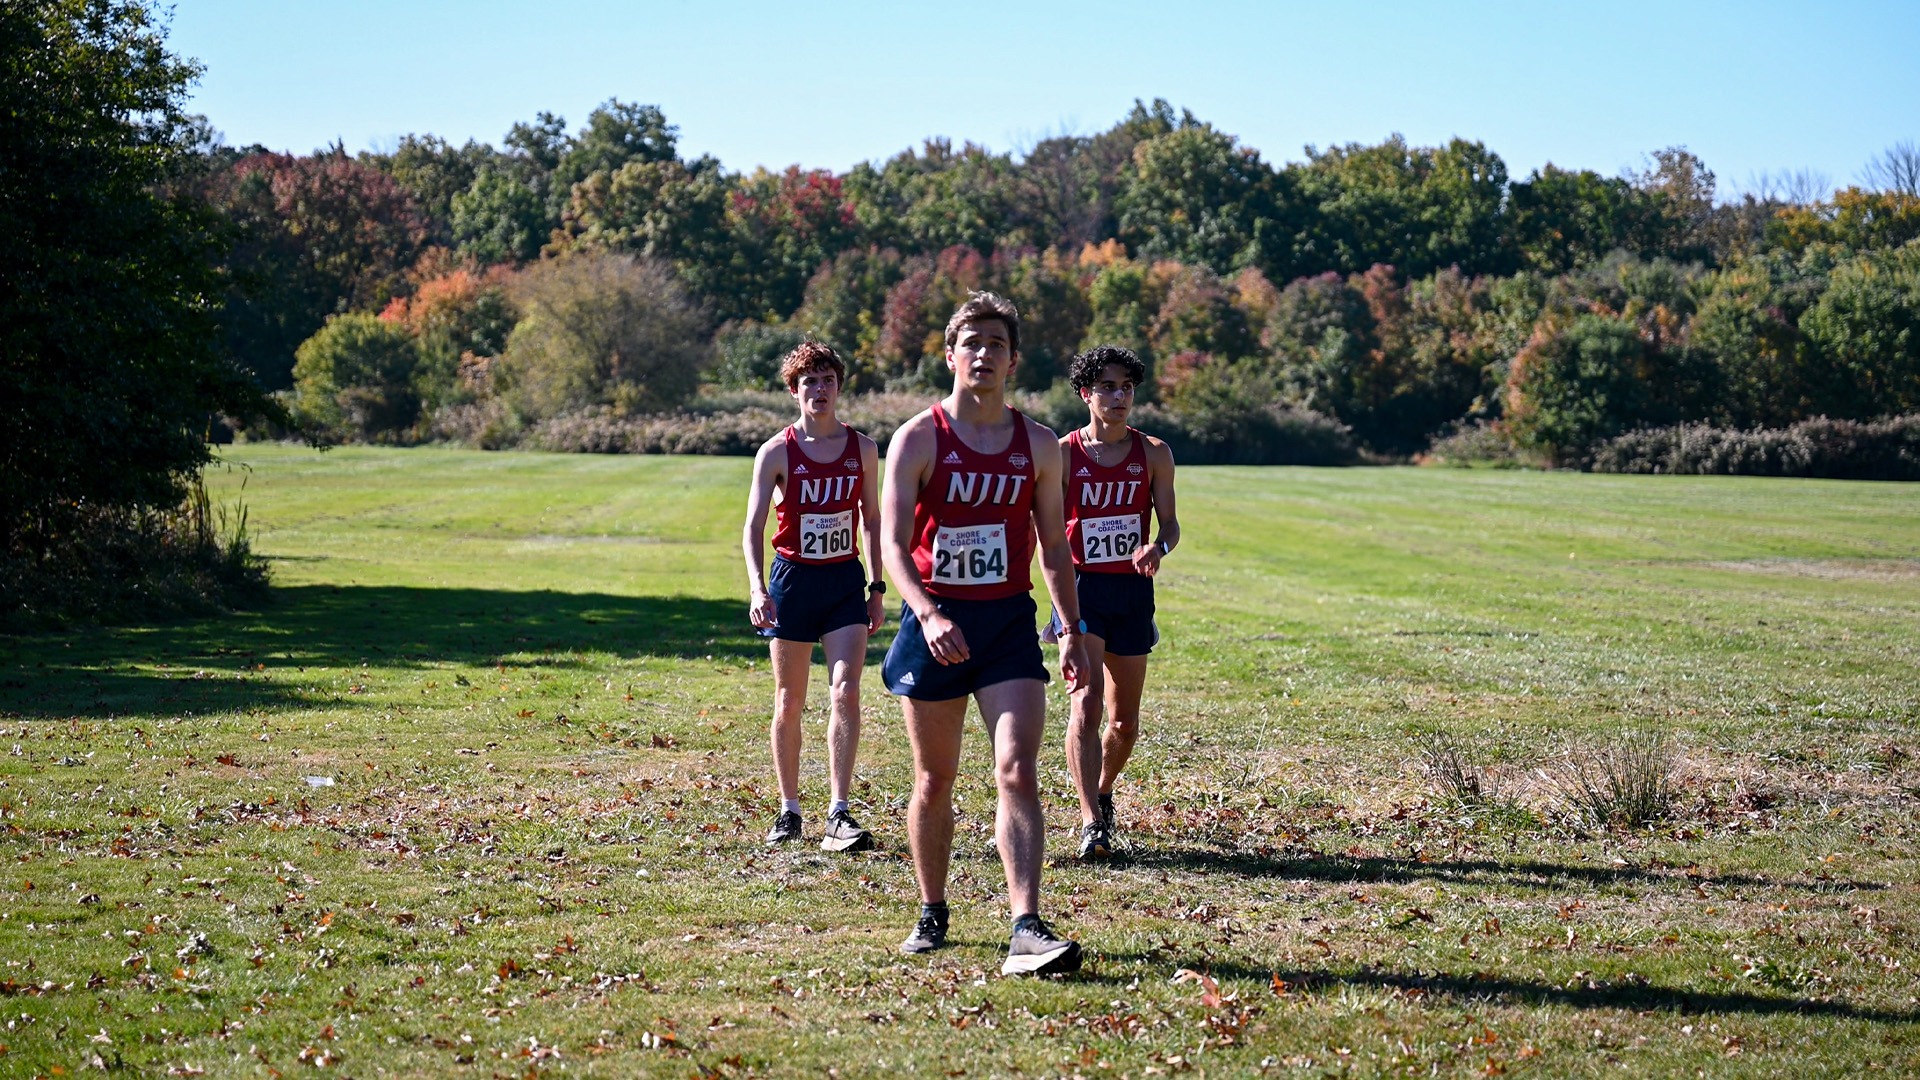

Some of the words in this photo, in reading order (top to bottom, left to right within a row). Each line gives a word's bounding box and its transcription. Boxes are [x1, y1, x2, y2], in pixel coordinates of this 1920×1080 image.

[800, 476, 858, 506] NJIT
[947, 471, 1027, 508] NJIT
[1081, 481, 1141, 510] NJIT
[803, 528, 850, 555] 2160
[950, 537, 987, 547] COACHES
[956, 530, 980, 539] SHORE
[1086, 532, 1139, 559] 2162
[935, 548, 1004, 579] 2164
